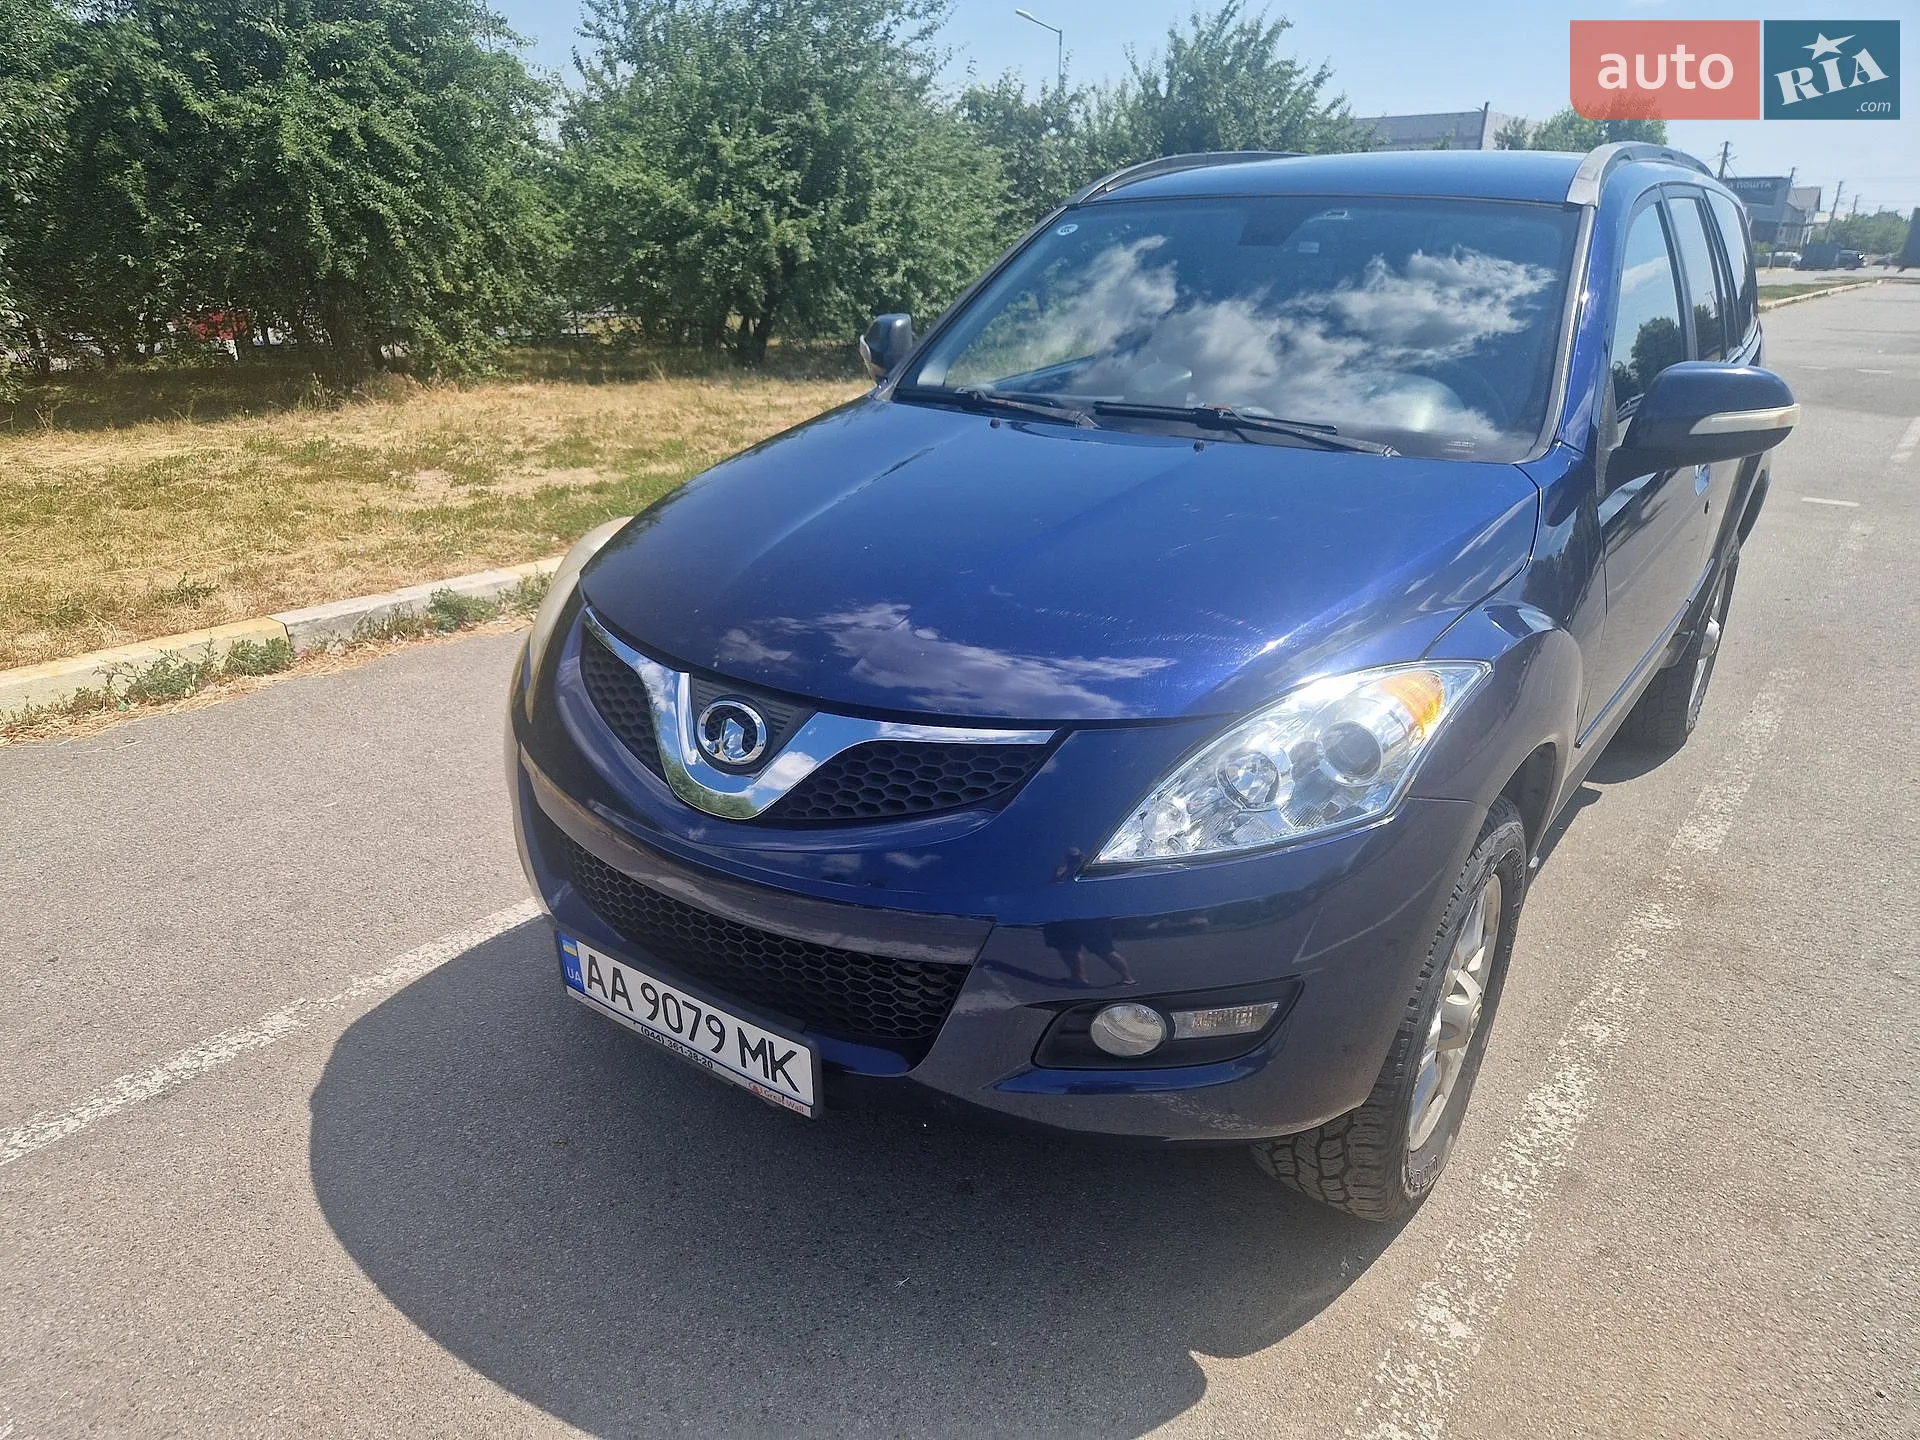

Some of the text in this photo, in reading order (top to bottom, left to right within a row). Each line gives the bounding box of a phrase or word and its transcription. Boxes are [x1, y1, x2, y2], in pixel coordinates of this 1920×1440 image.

[566, 965, 583, 984] UA
[587, 954, 801, 1094] AA 9079 MK
